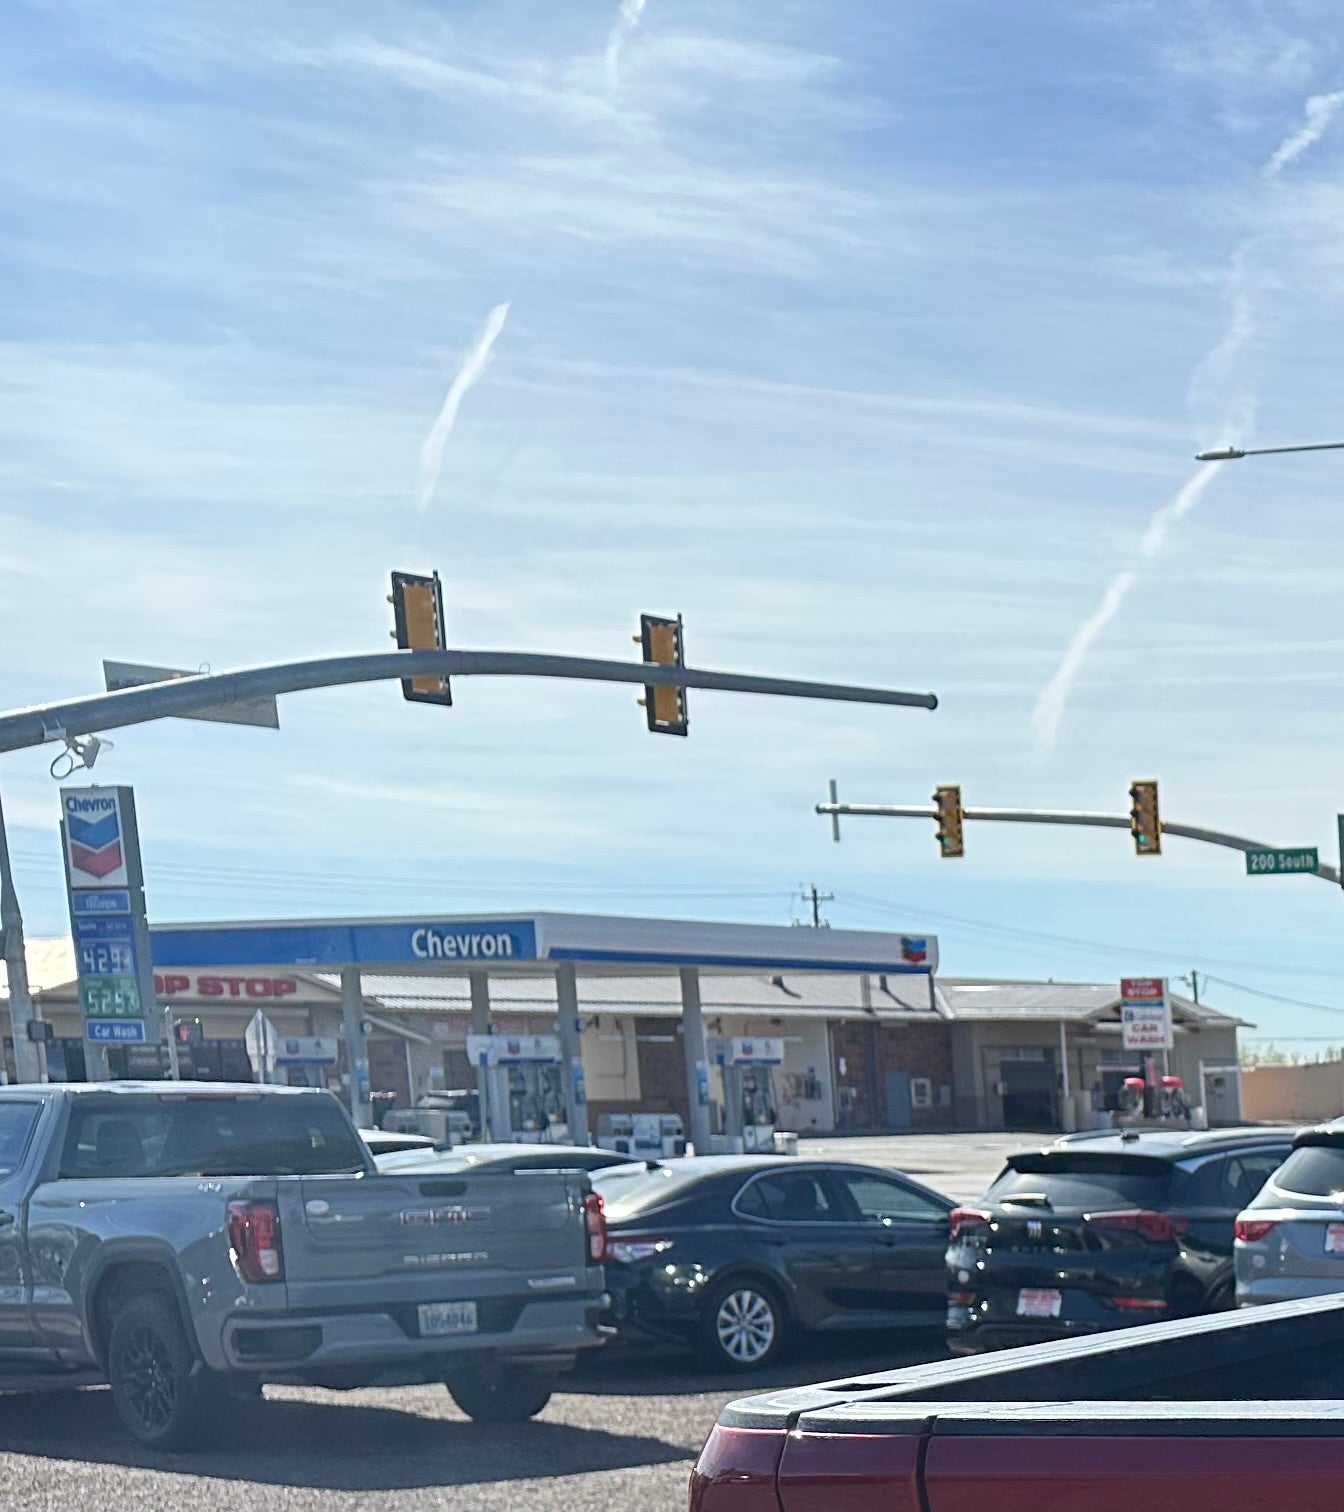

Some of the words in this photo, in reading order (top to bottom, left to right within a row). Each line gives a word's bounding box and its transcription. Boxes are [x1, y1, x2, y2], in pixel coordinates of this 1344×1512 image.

[66, 797, 116, 813] Chevron
[1251, 853, 1275, 871] 200
[1279, 853, 1314, 870] South
[411, 929, 512, 958] Chevron
[197, 976, 297, 997] STOP
[94, 1023, 111, 1038] Car
[113, 1023, 138, 1038] Wash
